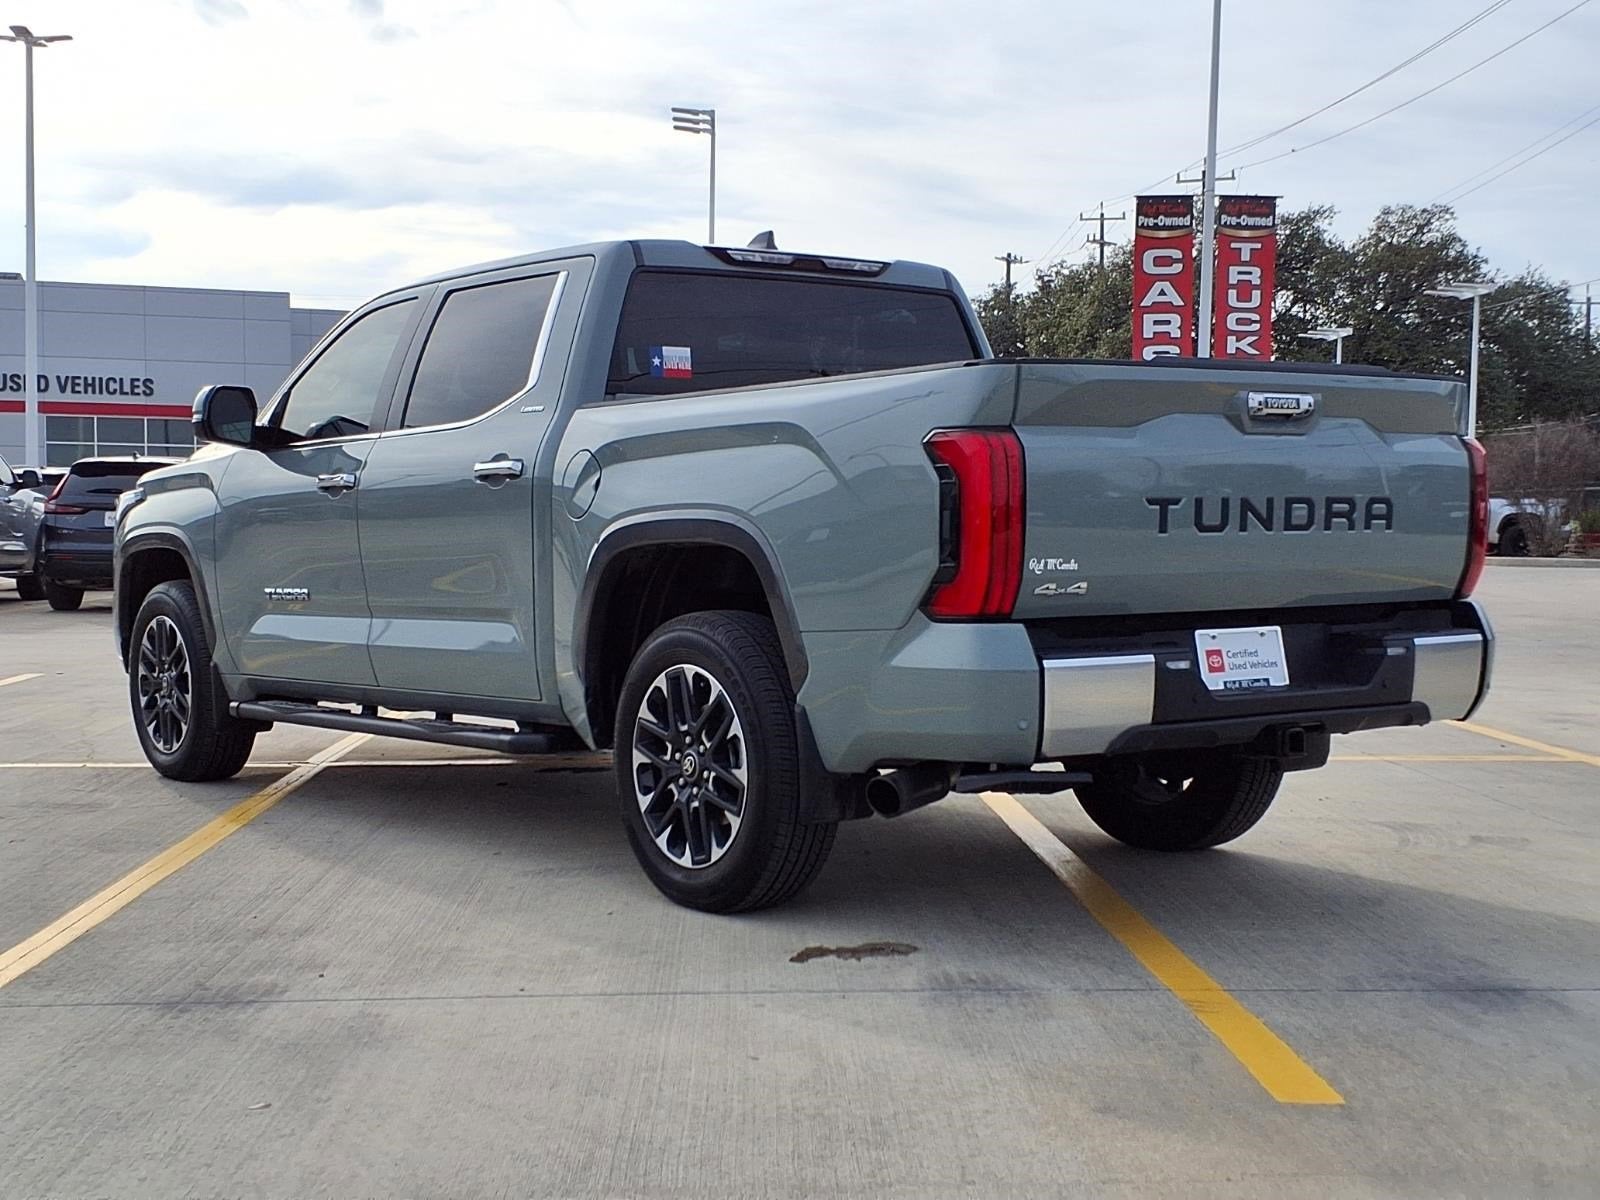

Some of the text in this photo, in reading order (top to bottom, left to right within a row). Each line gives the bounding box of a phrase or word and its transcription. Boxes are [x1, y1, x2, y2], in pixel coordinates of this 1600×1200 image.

[1138, 215, 1191, 227] Pre-Owned
[1221, 214, 1273, 226] Pre-Owned
[0, 373, 154, 397] USD VEHICLES
[1266, 398, 1298, 409] TOYOTA
[1144, 496, 1393, 536] TUNDRA
[1226, 649, 1259, 659] Certified
[1228, 660, 1278, 671] Used Vehicles
